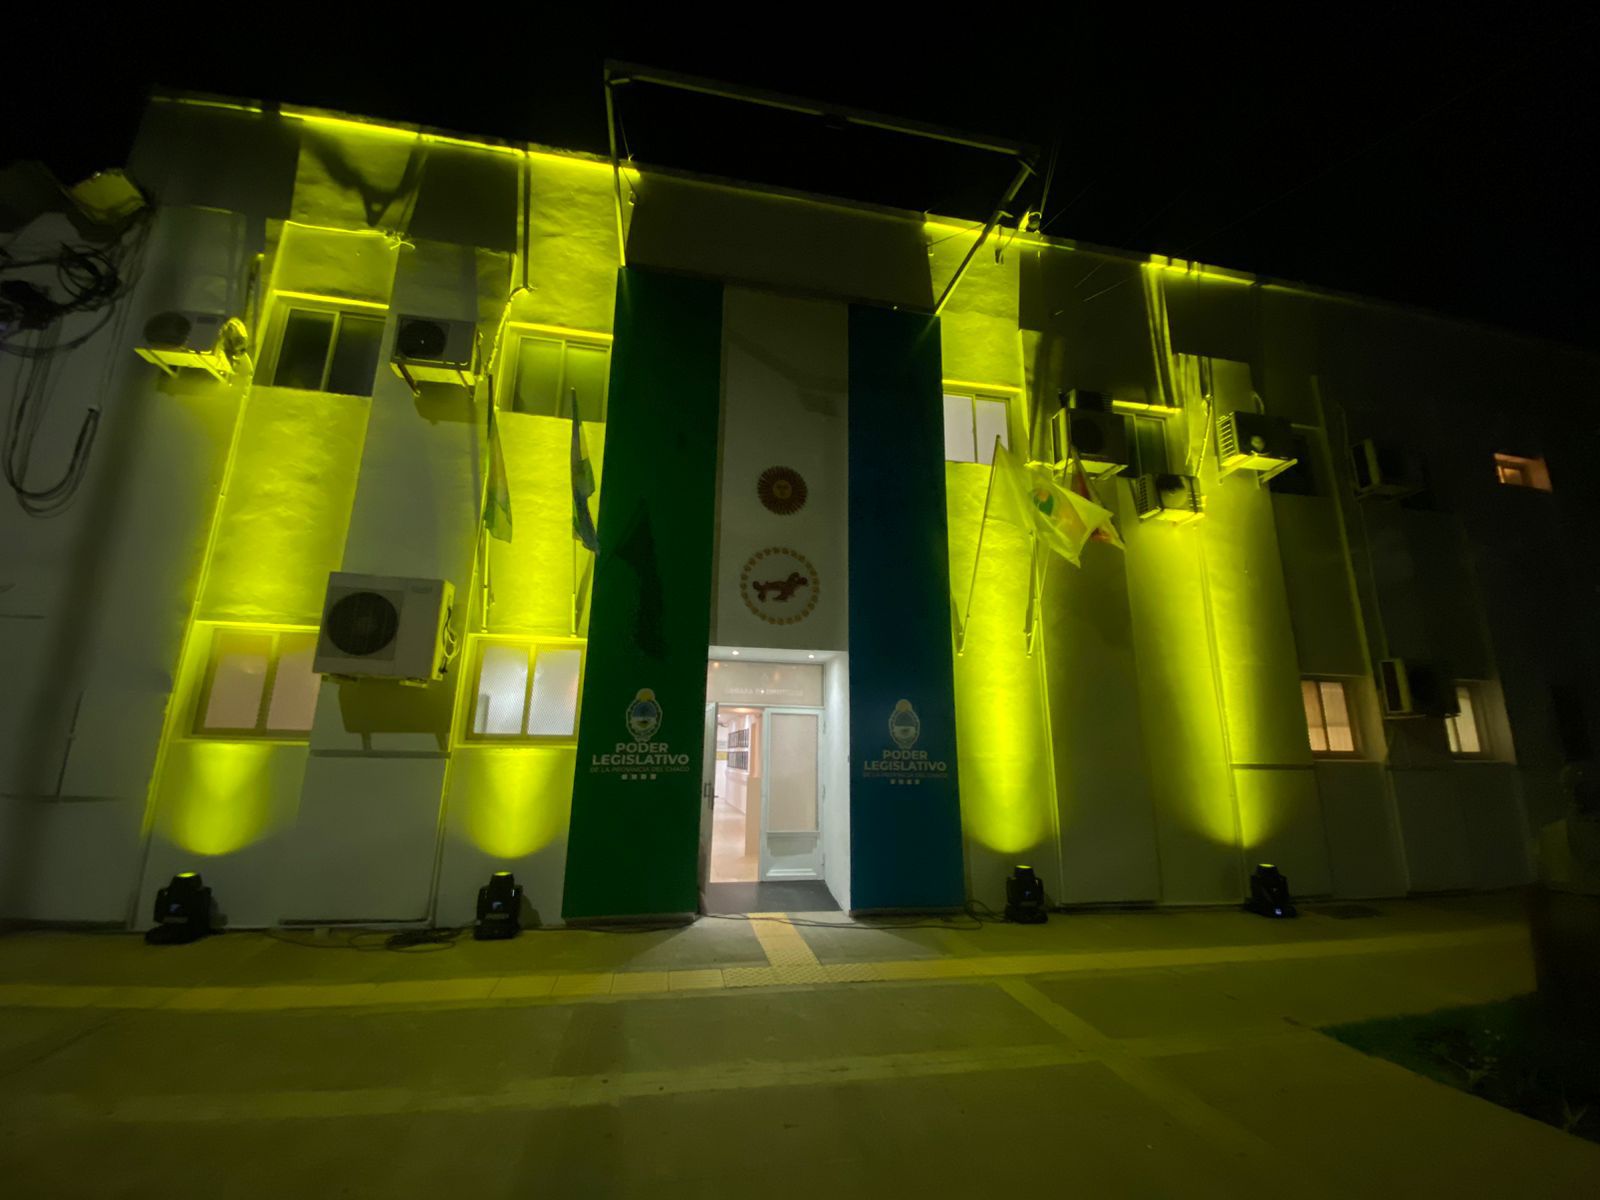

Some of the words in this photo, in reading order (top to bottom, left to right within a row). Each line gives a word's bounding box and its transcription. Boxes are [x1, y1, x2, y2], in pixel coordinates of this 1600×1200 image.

[615, 742, 669, 753] PODER
[592, 753, 690, 765] LEGISLATIVO
[882, 749, 928, 760] PODER
[864, 760, 947, 771] LEGISLATIVO
